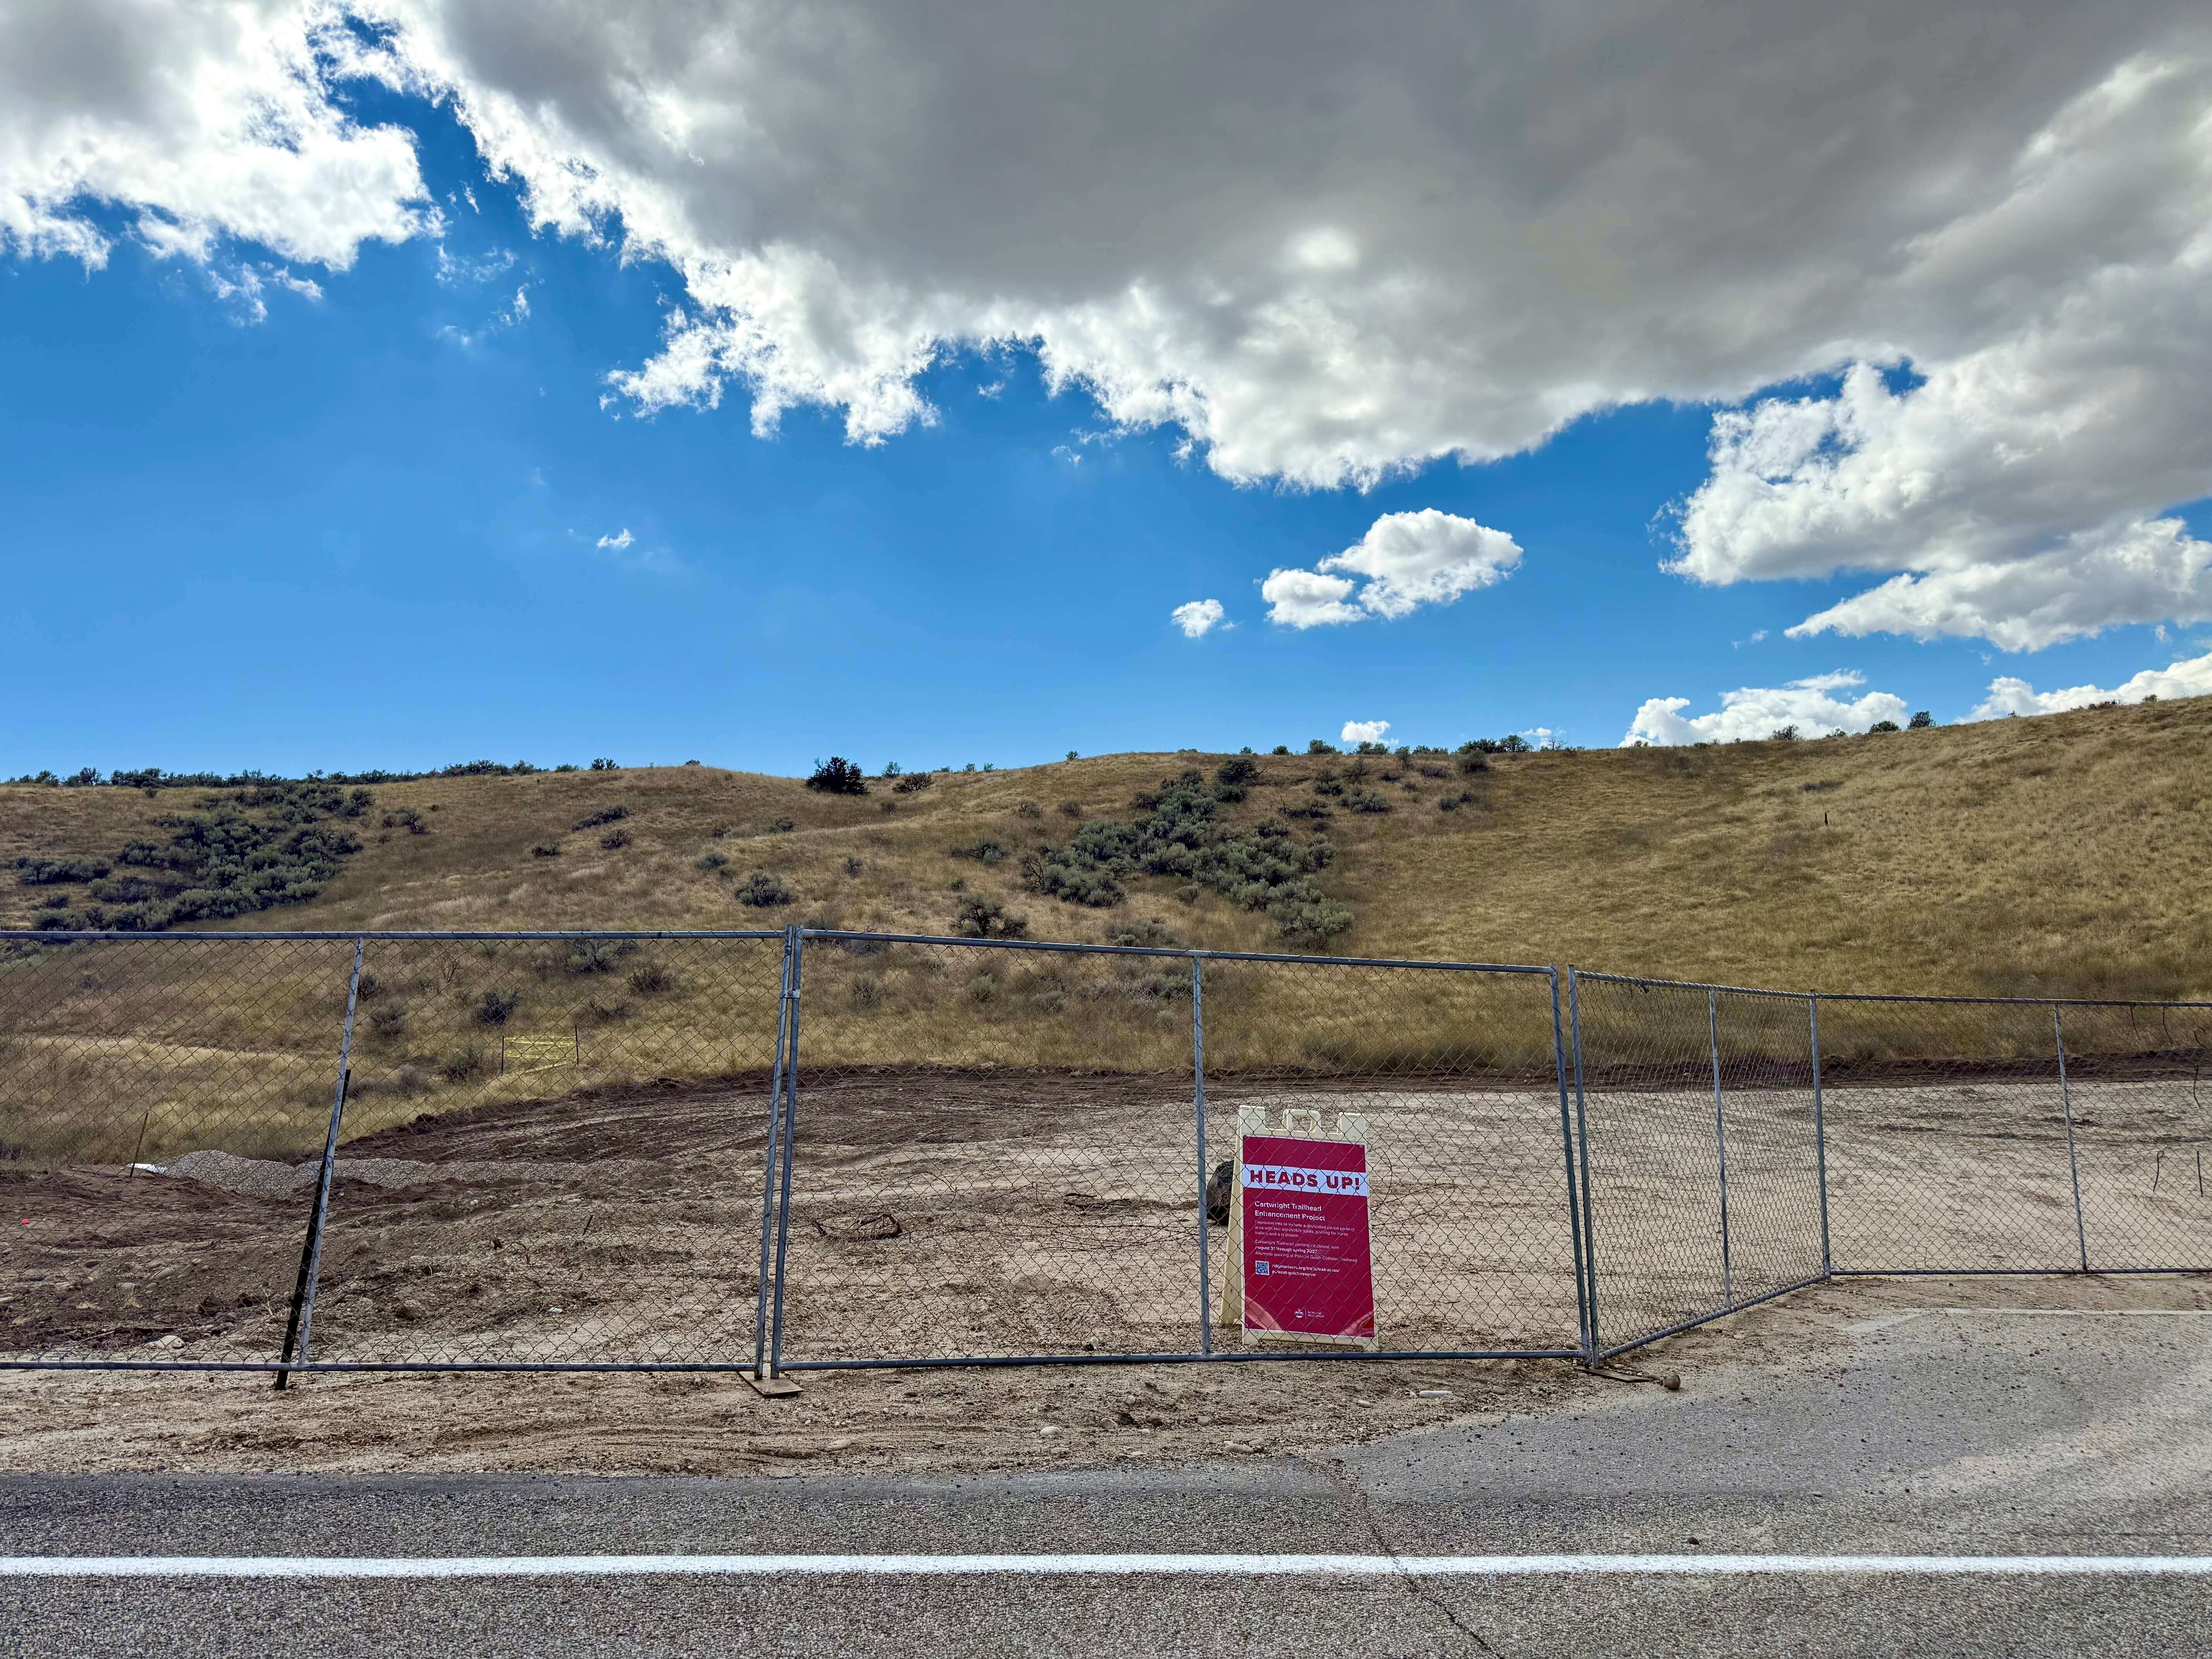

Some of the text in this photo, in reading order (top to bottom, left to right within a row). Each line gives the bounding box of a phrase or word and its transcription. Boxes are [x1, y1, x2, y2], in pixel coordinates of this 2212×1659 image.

[1250, 1170, 1359, 1190] HEADS UP!
[1255, 1201, 1321, 1211] Cartwright Trailhead
[1255, 1211, 1301, 1219] Enhancement
